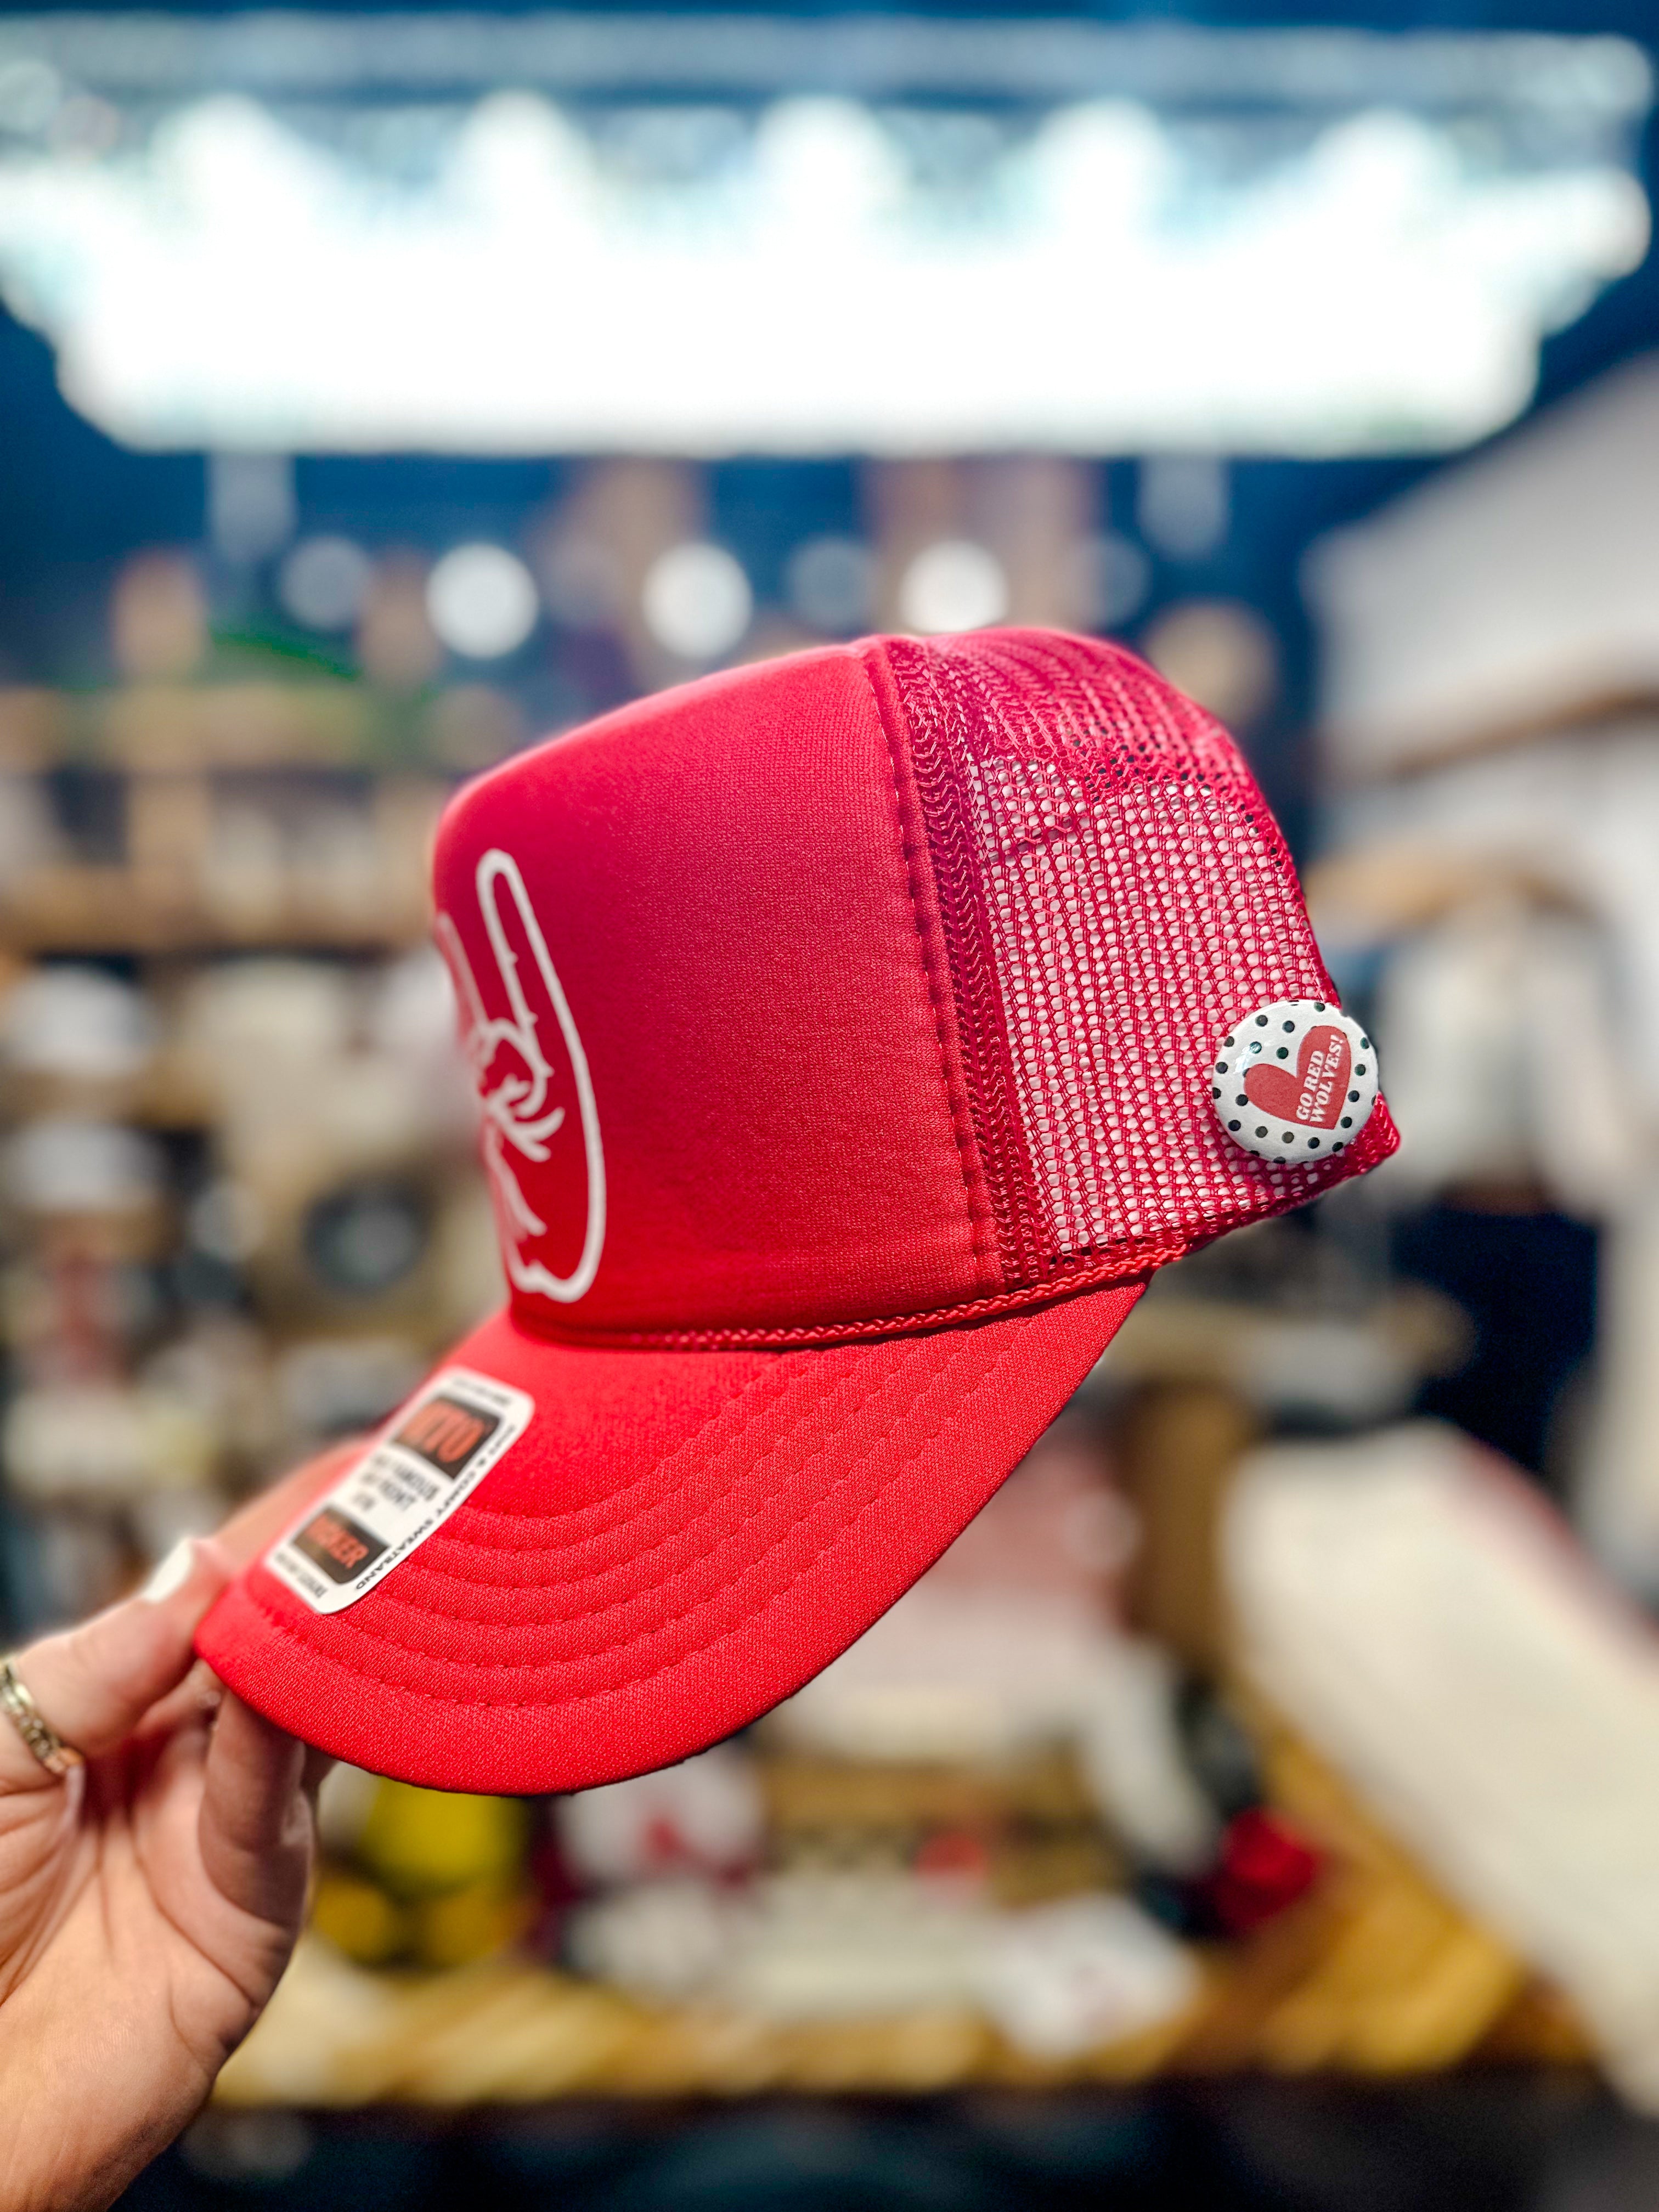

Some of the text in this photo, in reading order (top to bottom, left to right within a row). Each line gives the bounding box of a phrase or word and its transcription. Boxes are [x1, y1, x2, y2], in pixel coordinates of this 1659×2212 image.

[1296, 1050, 1324, 1121] GO RED
[1310, 1034, 1344, 1123] WOLVES!
[437, 1471, 476, 1515] COMFY
[356, 1519, 433, 1589] SWEATBAND
